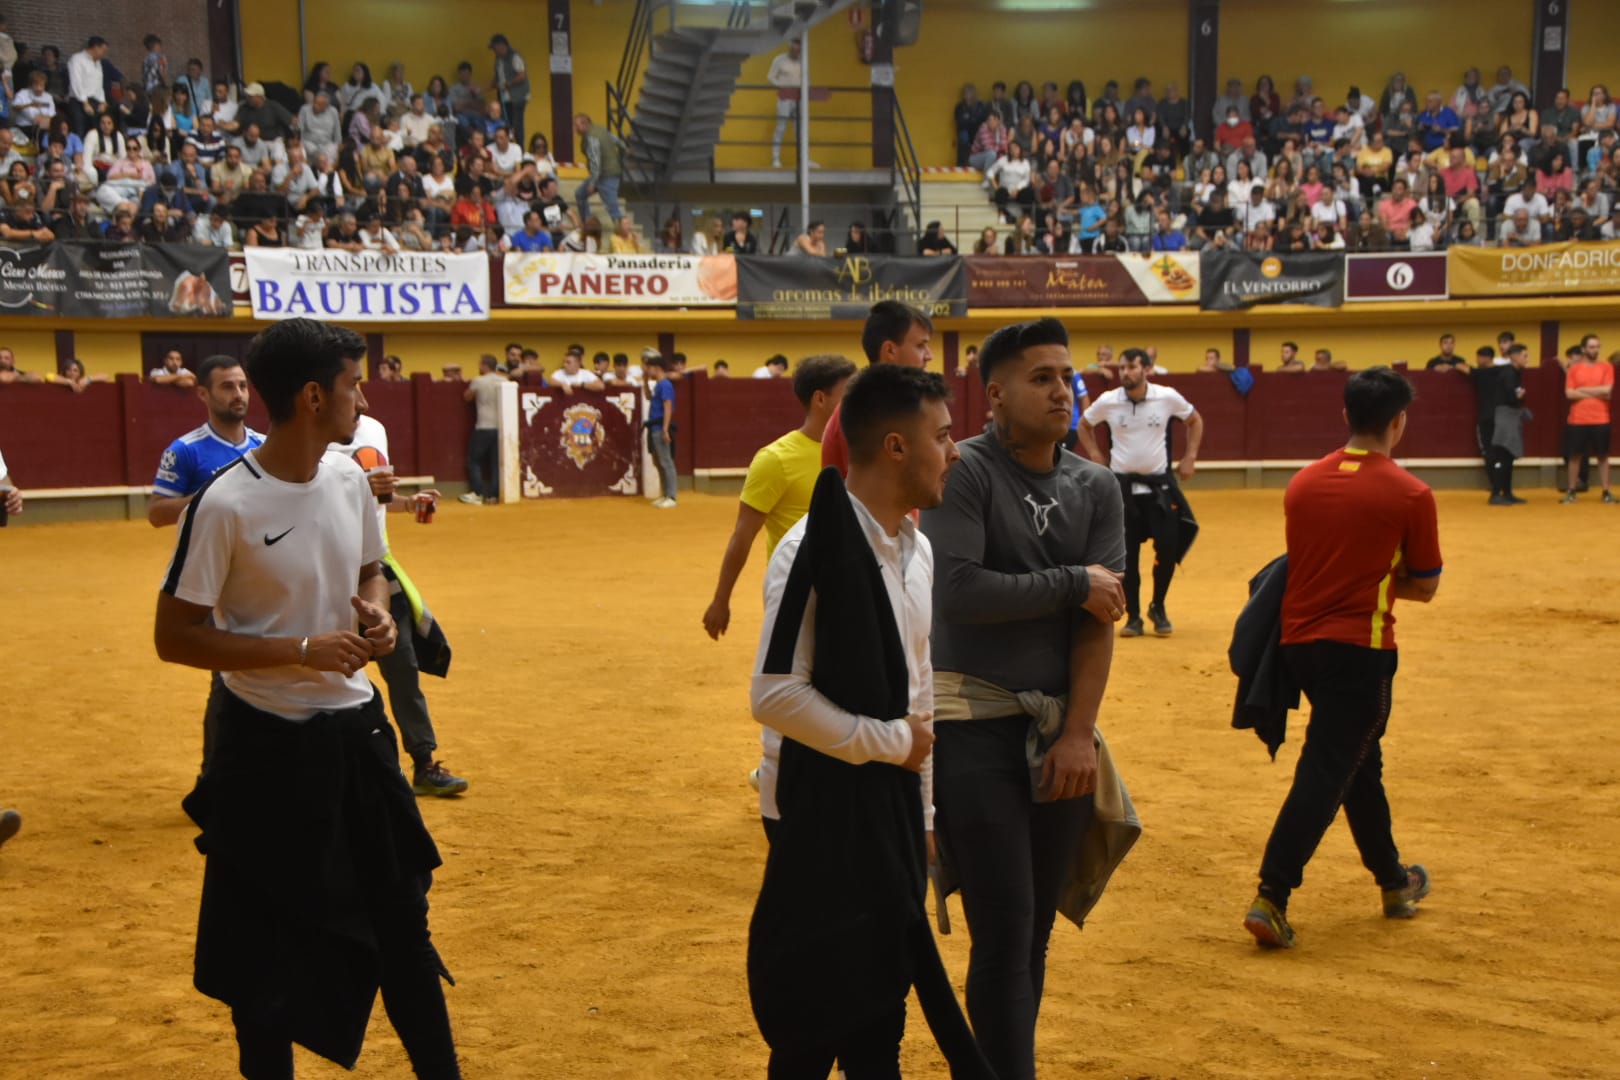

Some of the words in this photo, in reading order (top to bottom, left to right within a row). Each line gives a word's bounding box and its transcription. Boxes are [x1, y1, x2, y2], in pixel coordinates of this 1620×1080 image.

[554, 13, 565, 29] 7
[1201, 18, 1212, 36] 6
[290, 252, 447, 273] TRANSPORTES
[233, 267, 246, 289] 7
[539, 266, 670, 296] PAÑERO
[1393, 265, 1406, 287] 6
[255, 279, 484, 316] BAUTISTA
[772, 288, 843, 302] aromas
[868, 281, 930, 302] ibérico
[1223, 281, 1238, 296] EL
[1242, 279, 1321, 294] VENTORRO
